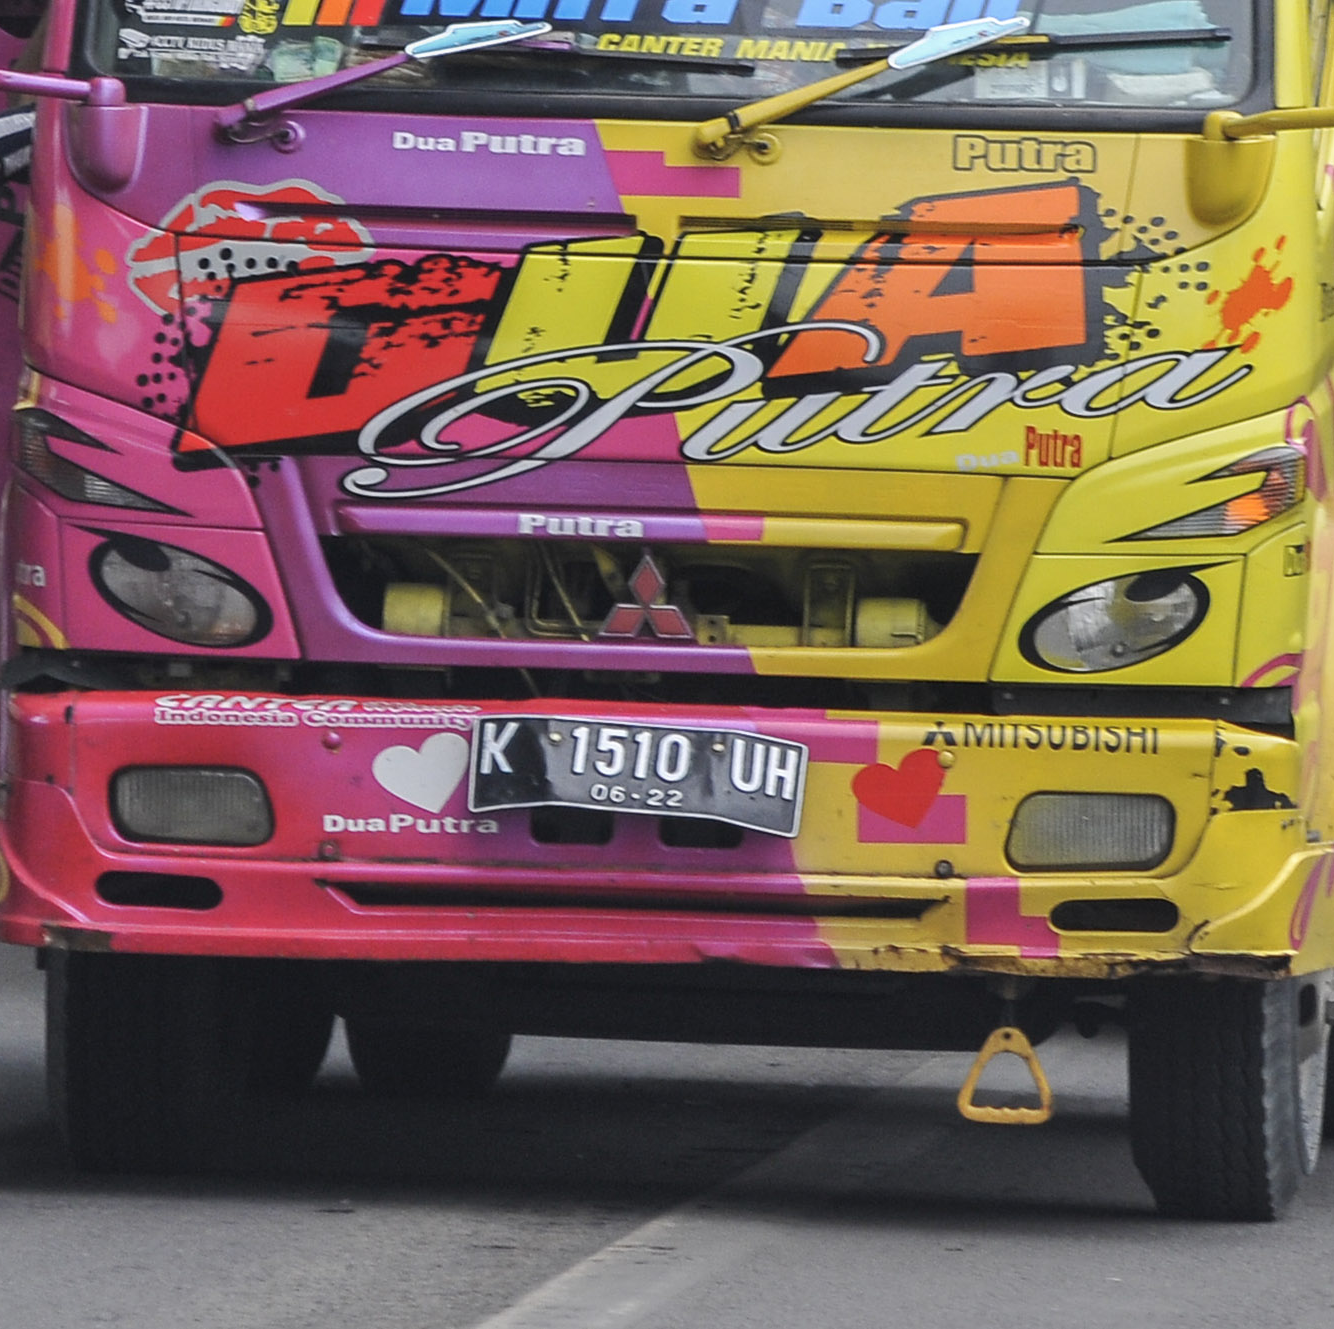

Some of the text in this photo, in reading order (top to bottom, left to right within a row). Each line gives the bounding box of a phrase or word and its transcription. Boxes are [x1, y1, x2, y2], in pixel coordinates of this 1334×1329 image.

[597, 32, 725, 59] CANTER
[392, 127, 586, 161] Dua Putra
[953, 133, 1098, 177] Putra
[175, 180, 1092, 465] DUA
[342, 322, 1253, 500] Putra
[1024, 424, 1083, 469] Putra
[518, 510, 645, 541] Putra
[155, 707, 474, 732] Indonesia Community
[963, 721, 1159, 755] MITSUBISHI
[479, 721, 800, 800] K 1510 UH
